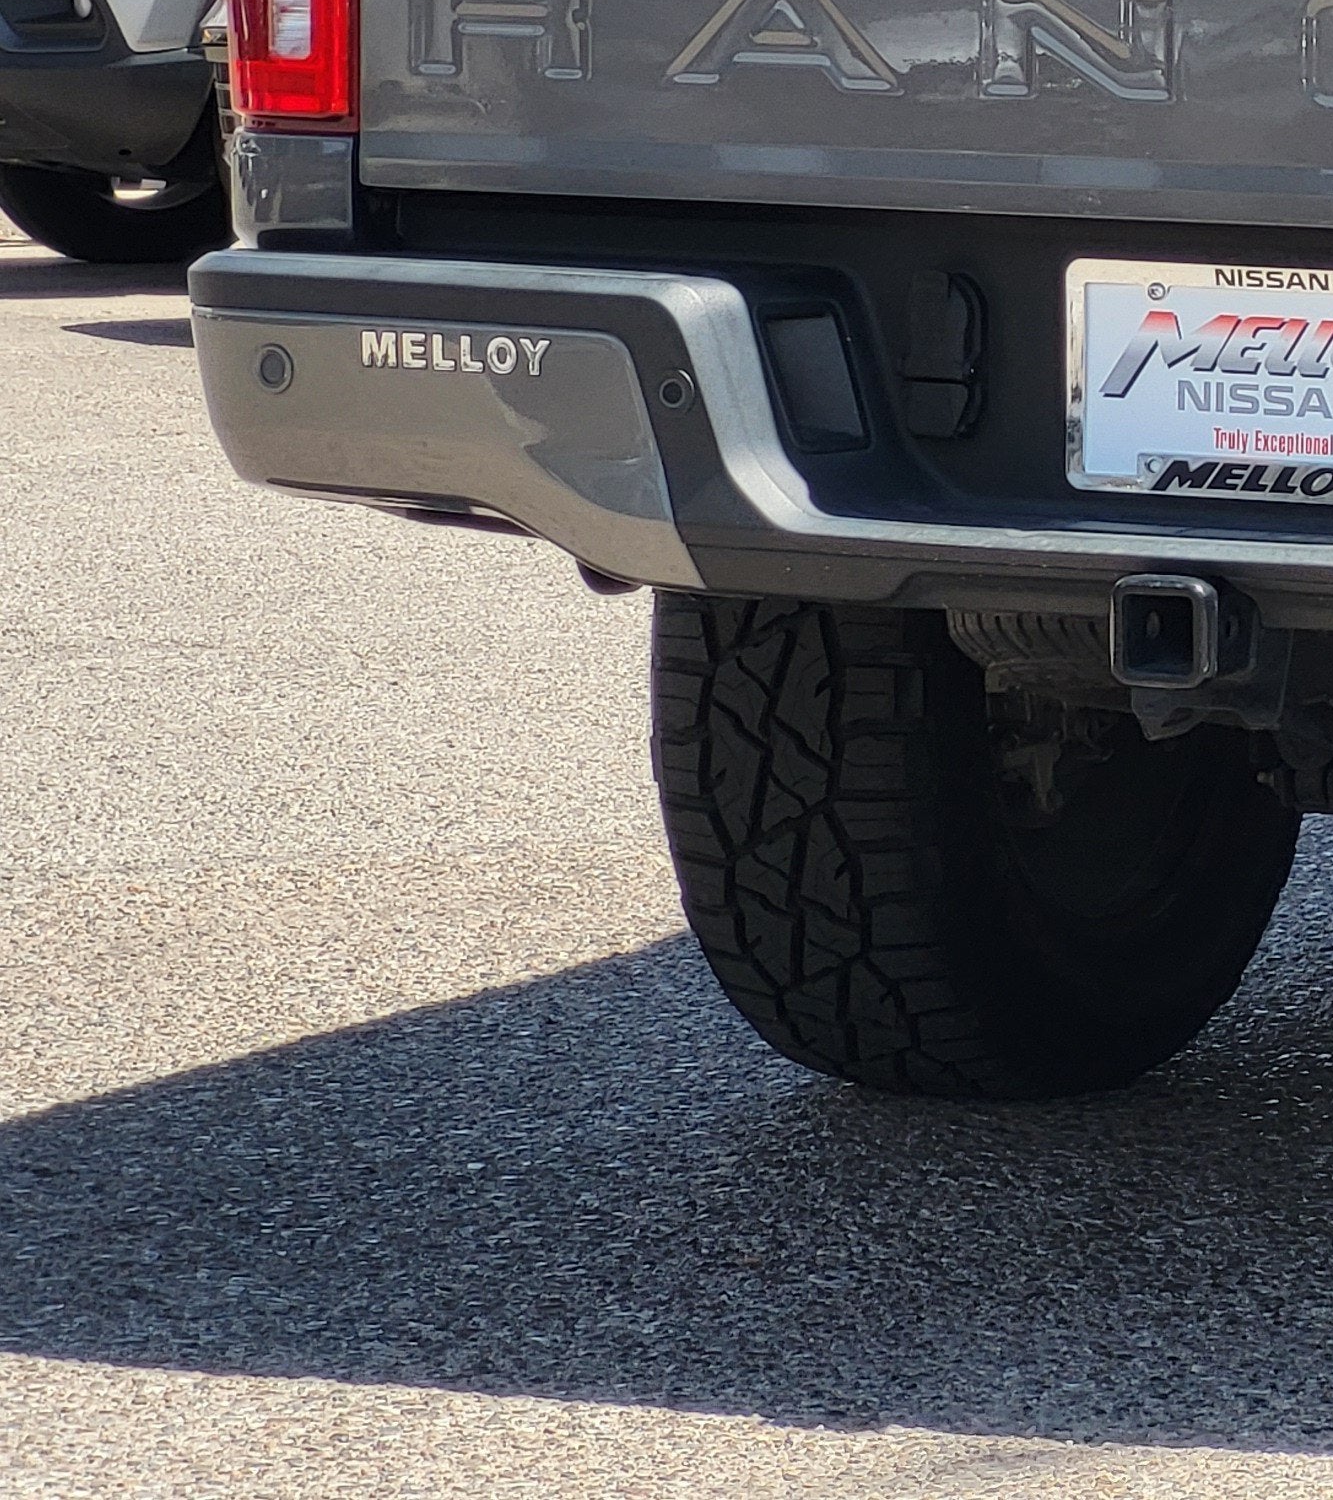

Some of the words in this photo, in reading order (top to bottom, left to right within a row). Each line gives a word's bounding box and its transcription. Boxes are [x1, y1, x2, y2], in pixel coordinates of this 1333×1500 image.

[1214, 268, 1330, 291] NISSAN
[360, 330, 551, 376] MELLOY
[1213, 427, 1249, 454] Truly
